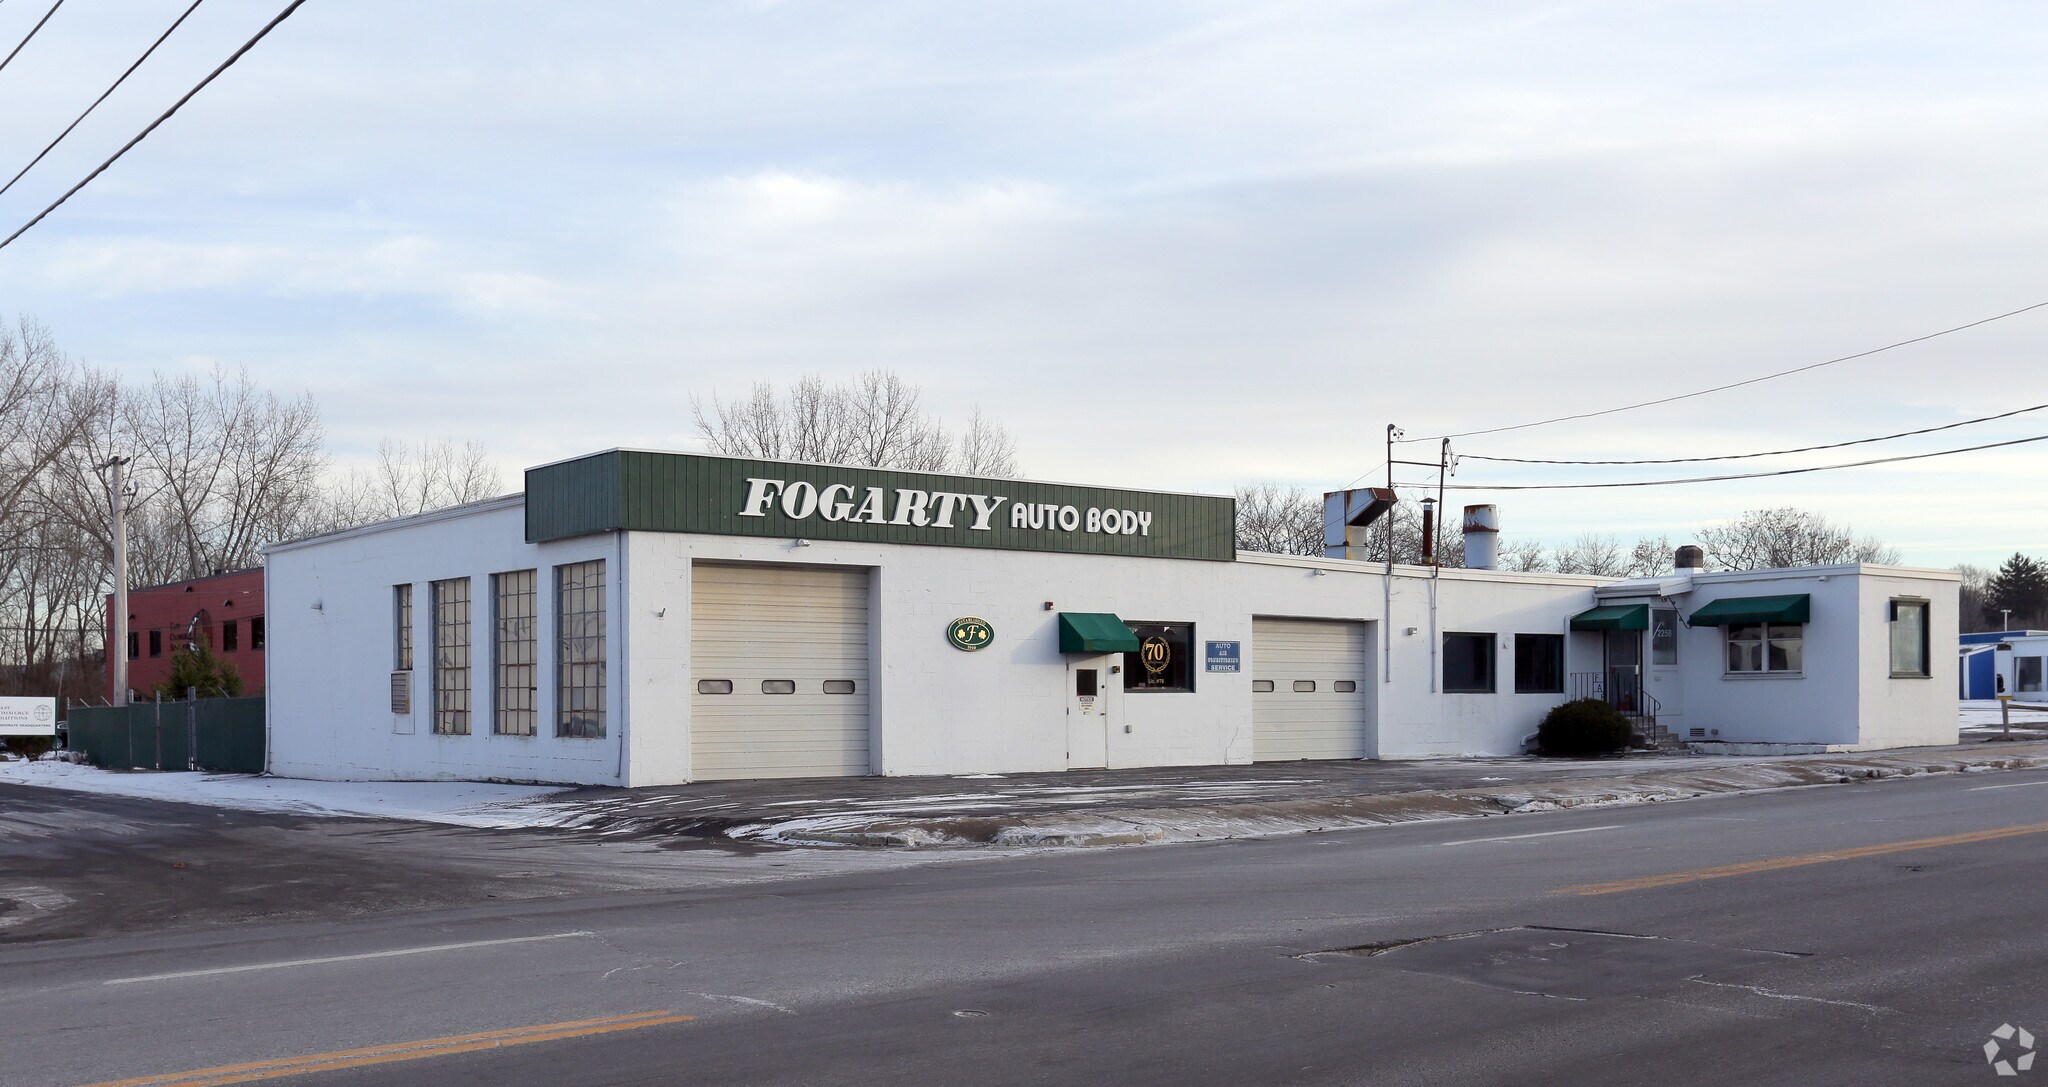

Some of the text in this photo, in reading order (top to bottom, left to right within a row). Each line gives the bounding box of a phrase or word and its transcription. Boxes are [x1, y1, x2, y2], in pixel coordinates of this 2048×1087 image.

[738, 477, 1153, 536] FOGARTY AUTO BODY
